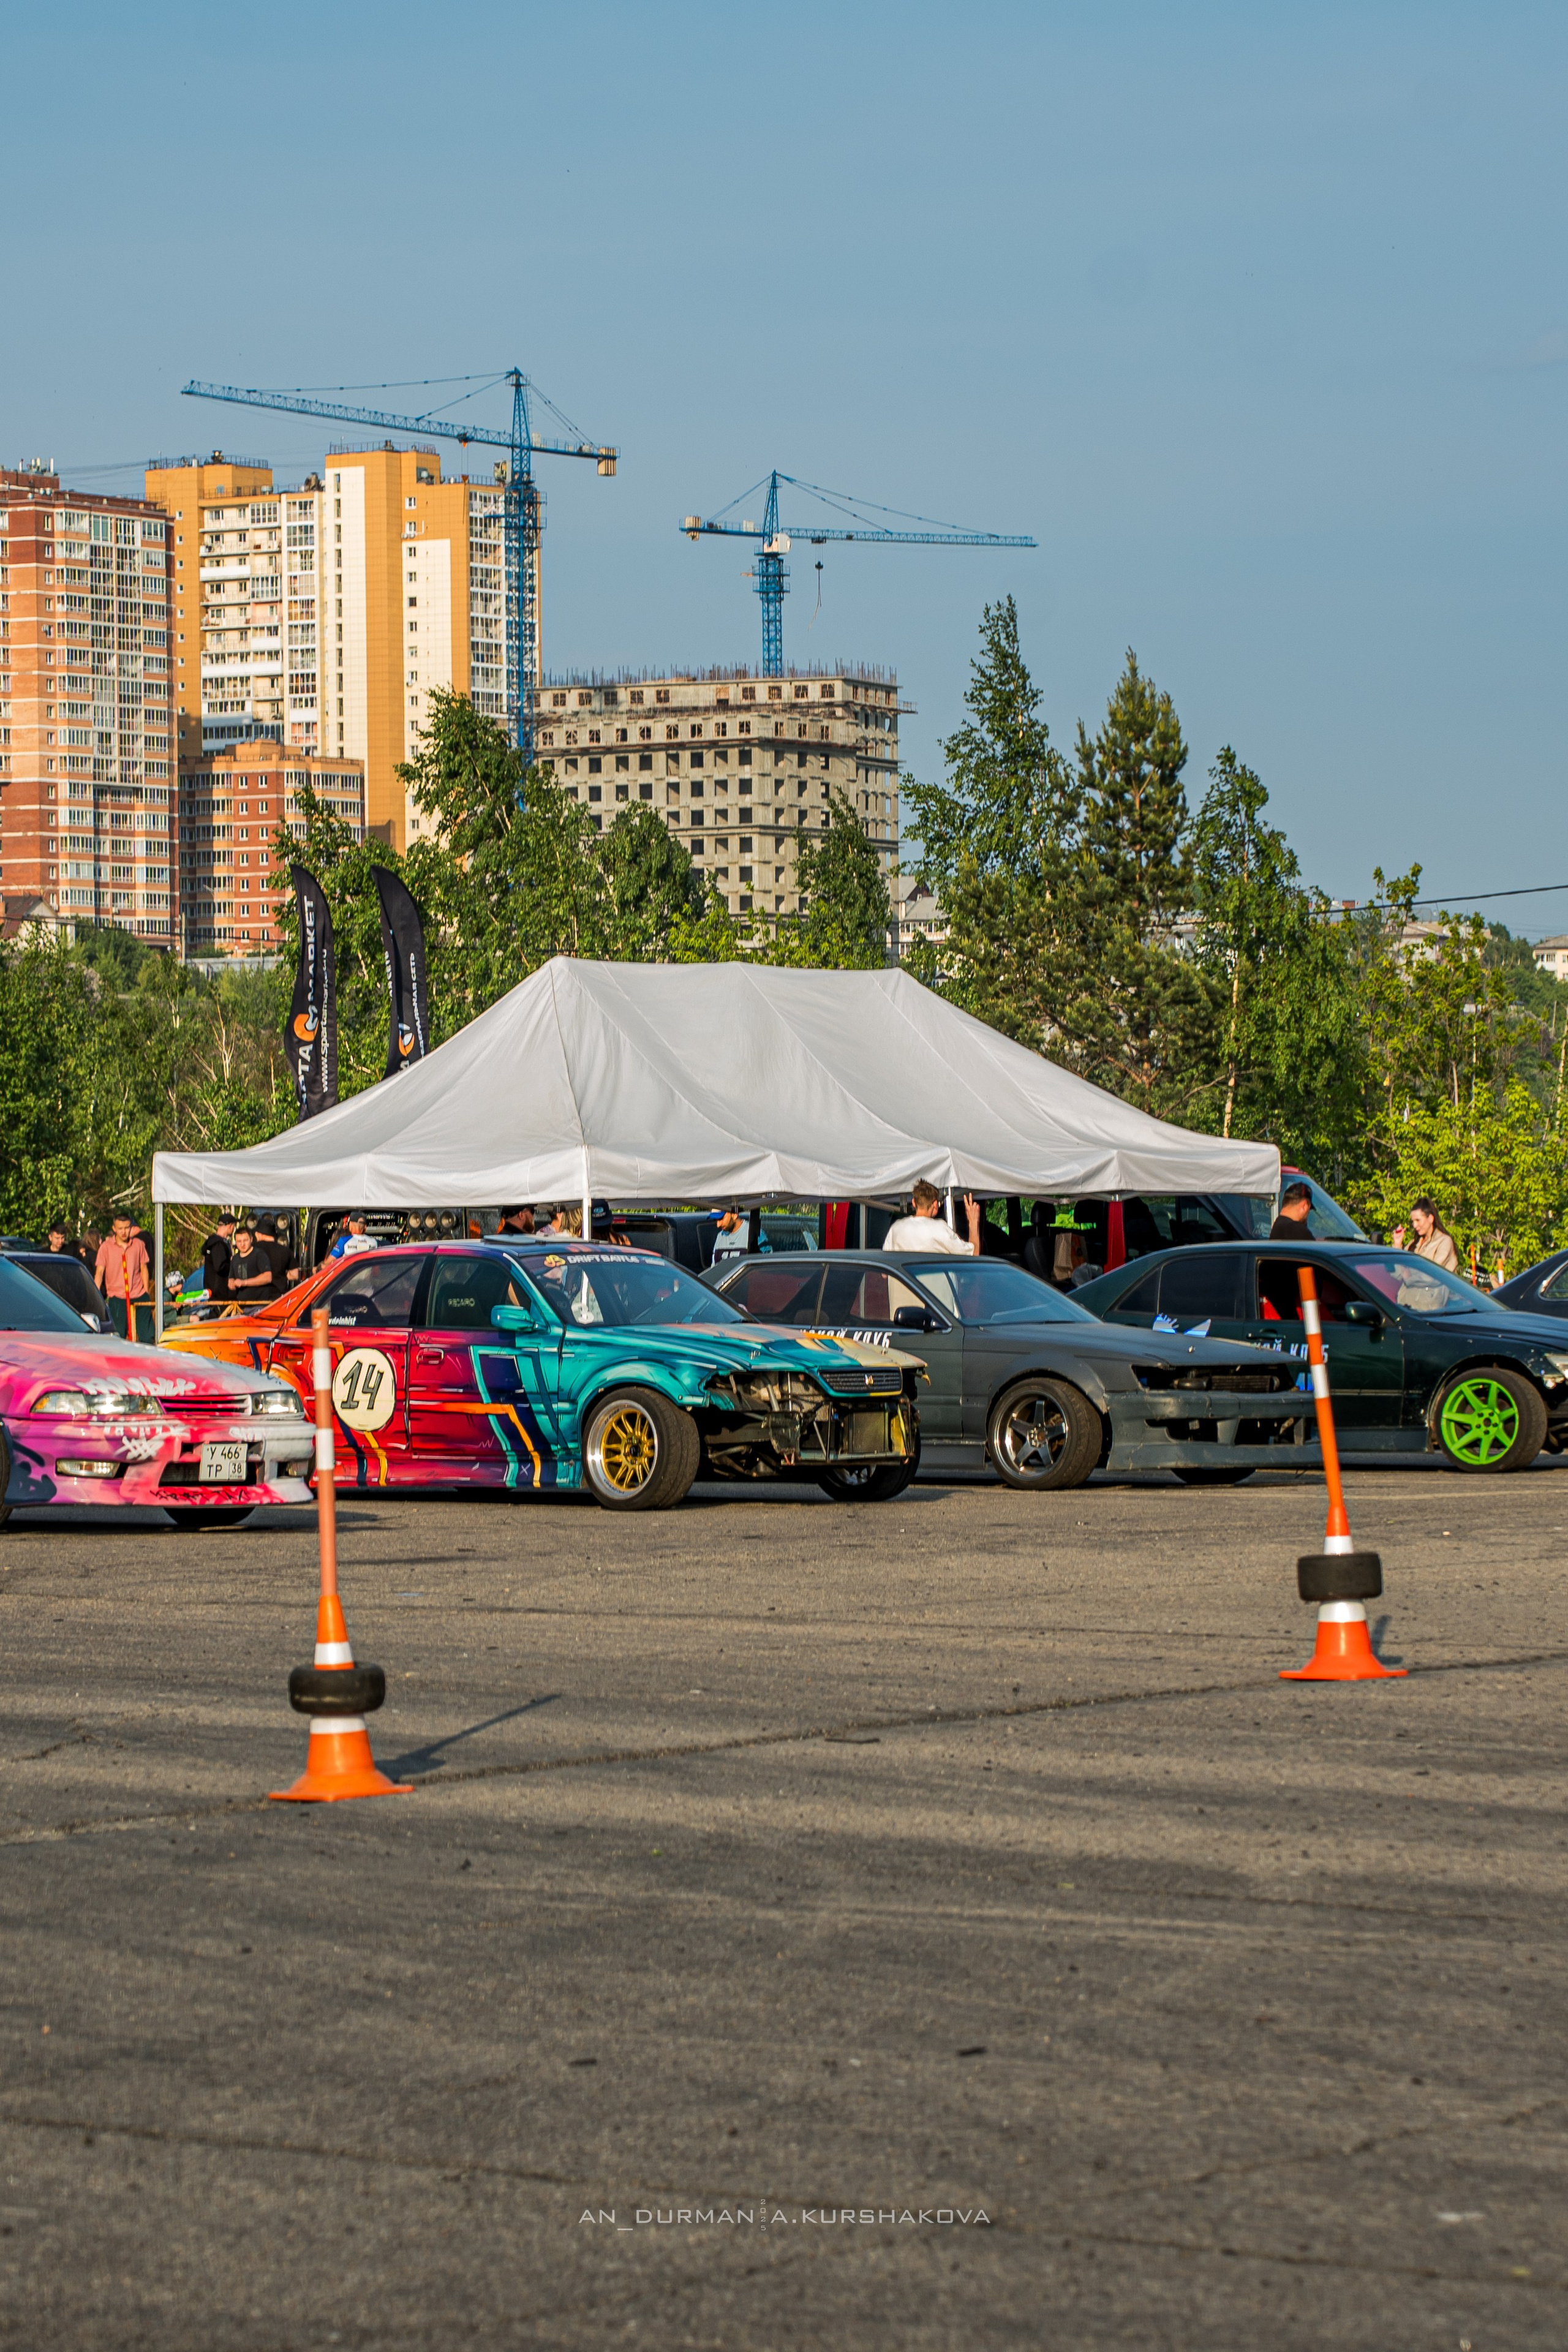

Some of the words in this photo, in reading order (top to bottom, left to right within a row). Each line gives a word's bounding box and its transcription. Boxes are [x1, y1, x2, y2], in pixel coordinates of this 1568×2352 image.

[567, 1254, 600, 1264] DRIFT
[340, 1359, 385, 1410] 14
[210, 1446, 217, 1460] У
[221, 1446, 240, 1460] 466
[207, 1464, 223, 1478] ТР
[232, 1462, 243, 1474] 38
